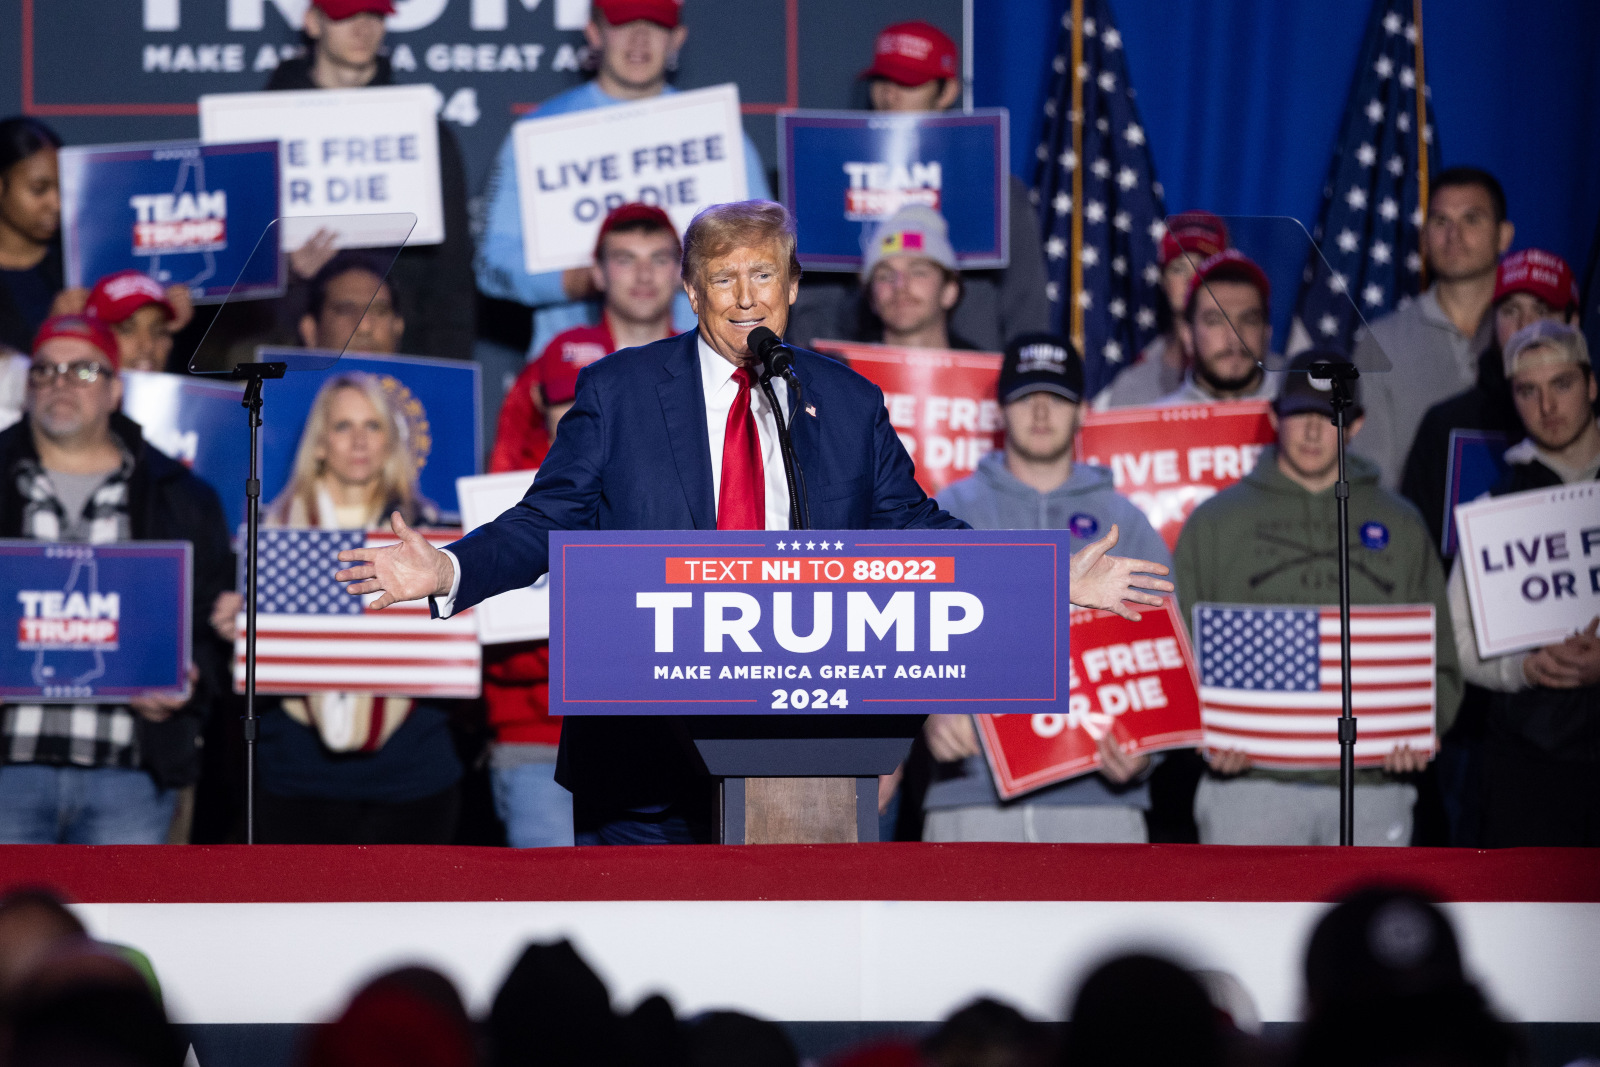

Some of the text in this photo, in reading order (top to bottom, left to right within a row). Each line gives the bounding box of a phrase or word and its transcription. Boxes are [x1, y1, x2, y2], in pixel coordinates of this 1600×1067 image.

[144, 44, 243, 72] MAKE
[425, 44, 544, 71] GREAT
[322, 134, 418, 167] FREE
[537, 134, 726, 191] LIVE FREE
[326, 174, 388, 204] DIE
[844, 161, 942, 189] TEAM
[130, 190, 227, 222] TEAM
[924, 396, 1004, 432] FRE
[1087, 449, 1180, 487] IVE
[1481, 531, 1570, 573] LIVE
[684, 559, 937, 581] TEXT NH TO 88022
[1521, 570, 1577, 602] OR
[18, 590, 120, 619] TEAM
[636, 590, 985, 654] TRUMP
[653, 664, 967, 680] MAKE AMERICA GREAT AGAIN!
[1081, 636, 1185, 683] FREE
[771, 688, 849, 710] 2024
[1096, 675, 1169, 717] DIE
